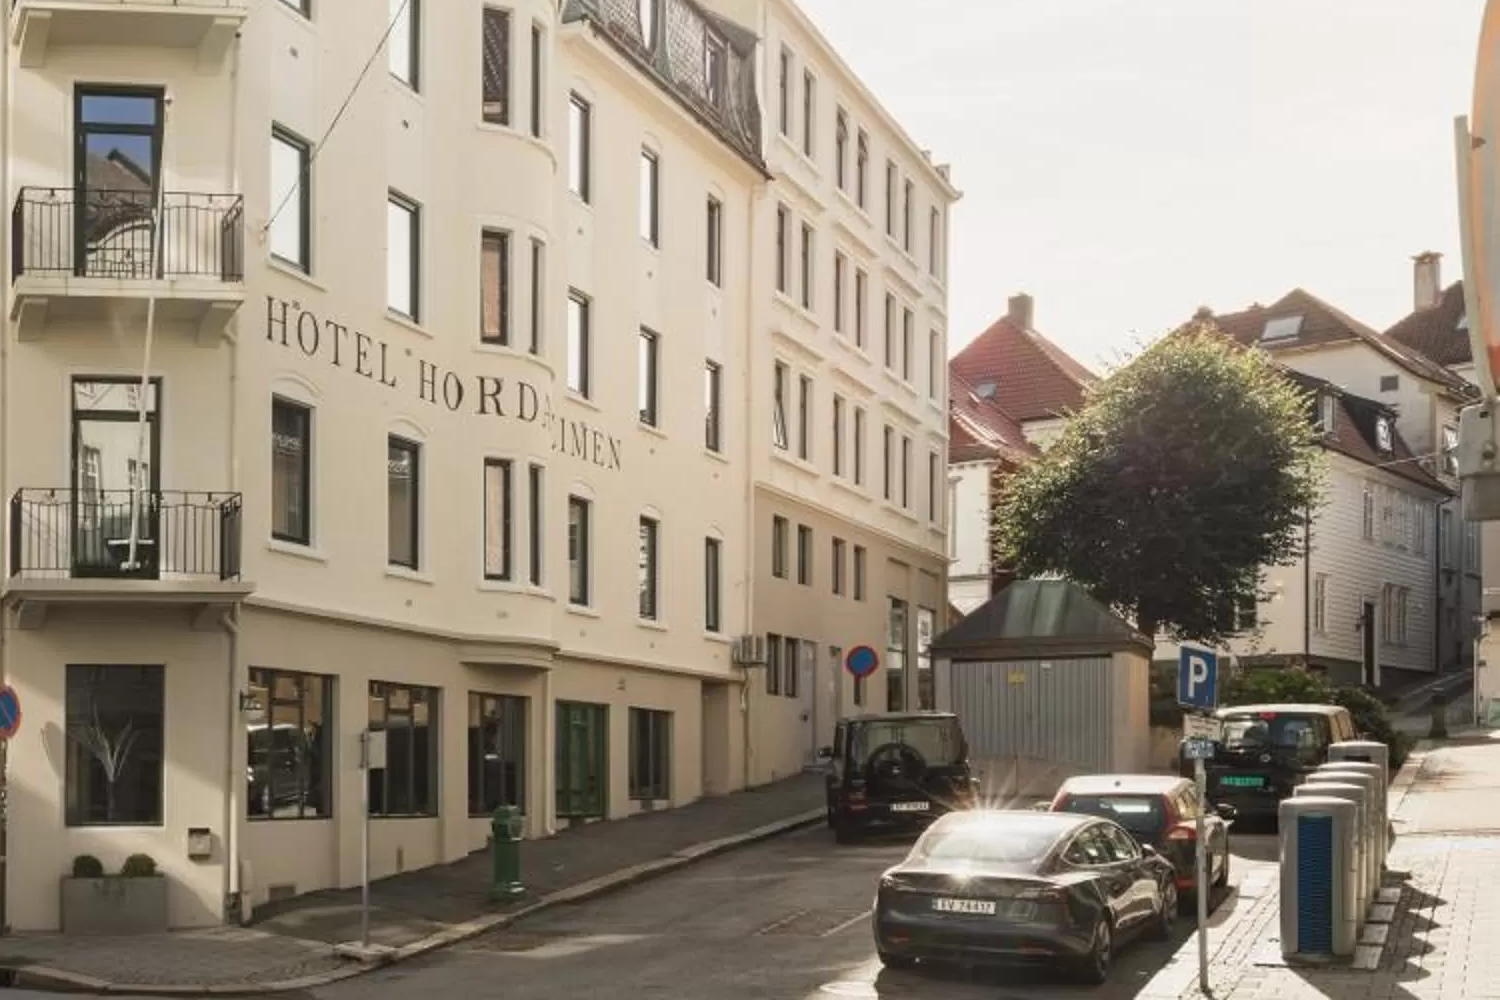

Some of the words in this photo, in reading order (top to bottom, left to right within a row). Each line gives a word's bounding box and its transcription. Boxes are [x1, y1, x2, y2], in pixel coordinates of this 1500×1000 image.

[266, 295, 397, 388] HOTEL
[419, 359, 622, 472] HORDIMEN
[1187, 654, 1208, 699] P
